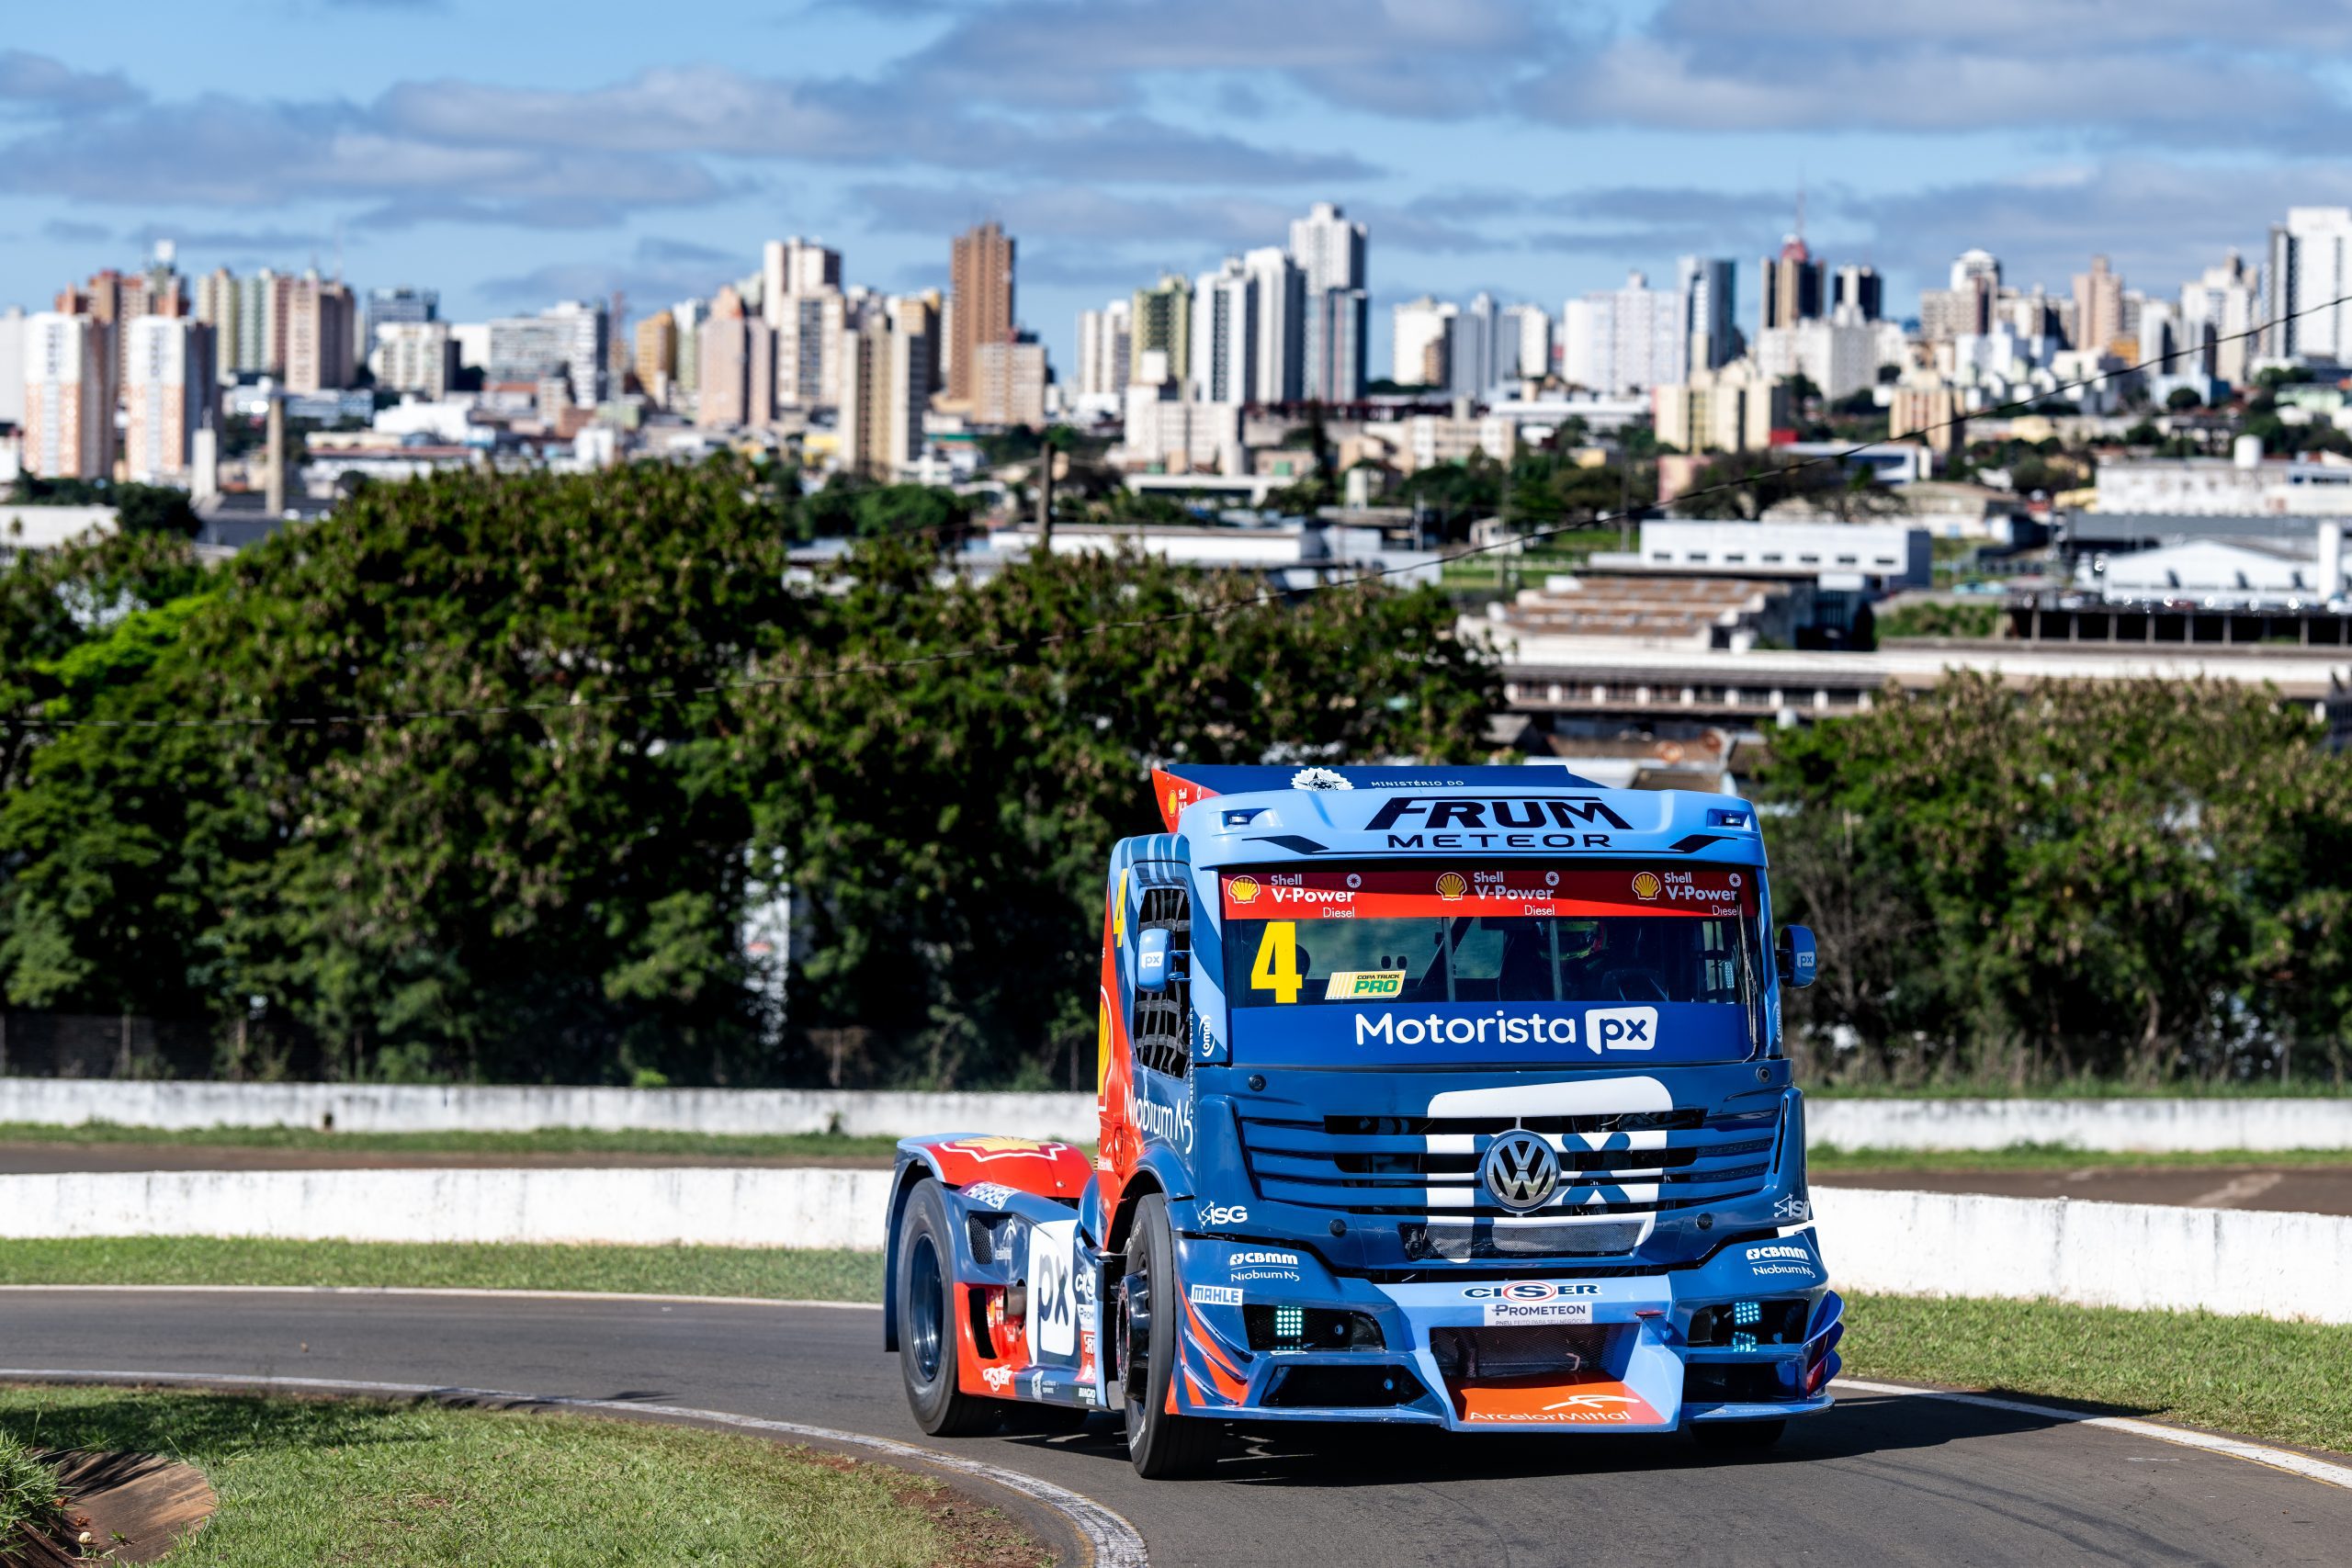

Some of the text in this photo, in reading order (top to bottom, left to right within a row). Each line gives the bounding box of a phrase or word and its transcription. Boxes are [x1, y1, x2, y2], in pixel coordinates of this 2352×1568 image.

[1363, 795, 1634, 830] FRUM
[1386, 833, 1612, 849] METEOR
[1271, 874, 1303, 886] Shell
[1474, 871, 1504, 884] Shell
[1664, 872, 1692, 884] Shell
[1271, 887, 1355, 903] V-Power
[1474, 885, 1555, 900] V-Power
[1666, 885, 1737, 901] V-Power
[1114, 867, 1128, 948] 4
[1322, 907, 1355, 919] Diesel
[1524, 904, 1555, 916] Diesel
[1712, 905, 1740, 916] Diesel
[1250, 921, 1303, 1004] 4
[1353, 979, 1398, 994] PRO
[1355, 1010, 1577, 1045] Motorista
[1203, 1021, 1211, 1050] omni
[1124, 1082, 1173, 1139] Niobium
[1209, 1205, 1248, 1225] ISG
[1231, 1269, 1283, 1282] Niobium
[1752, 1264, 1802, 1276] Niobium
[1193, 1287, 1239, 1303] MAHLE
[1464, 1282, 1600, 1301] CISER
[1492, 1303, 1586, 1316] PROMETEON
[1470, 1410, 1633, 1421] ArcelorMittal
